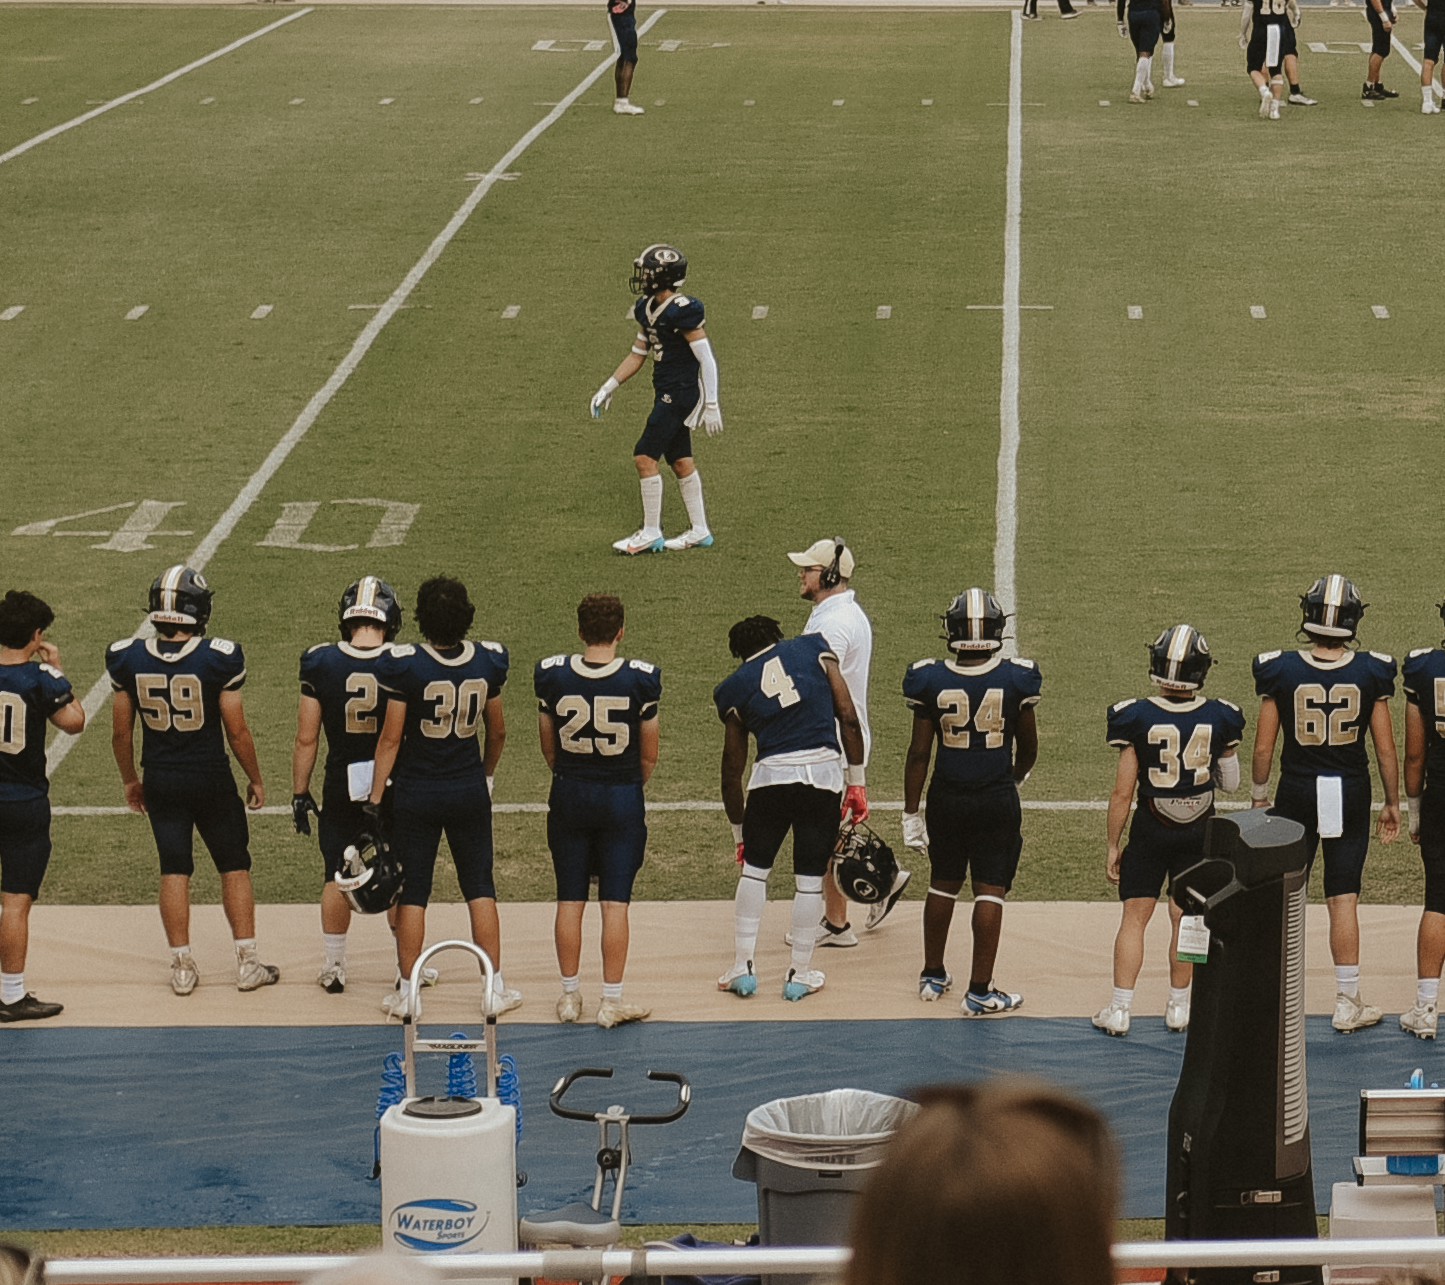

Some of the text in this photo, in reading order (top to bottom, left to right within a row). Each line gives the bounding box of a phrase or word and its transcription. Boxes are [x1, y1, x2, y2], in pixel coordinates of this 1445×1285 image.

[134, 673, 205, 732] 59
[420, 677, 489, 739] 30
[759, 655, 802, 709] 4
[555, 694, 630, 756] 25
[936, 688, 1005, 750] 24
[1293, 683, 1361, 747] 62
[1146, 723, 1213, 789] 34
